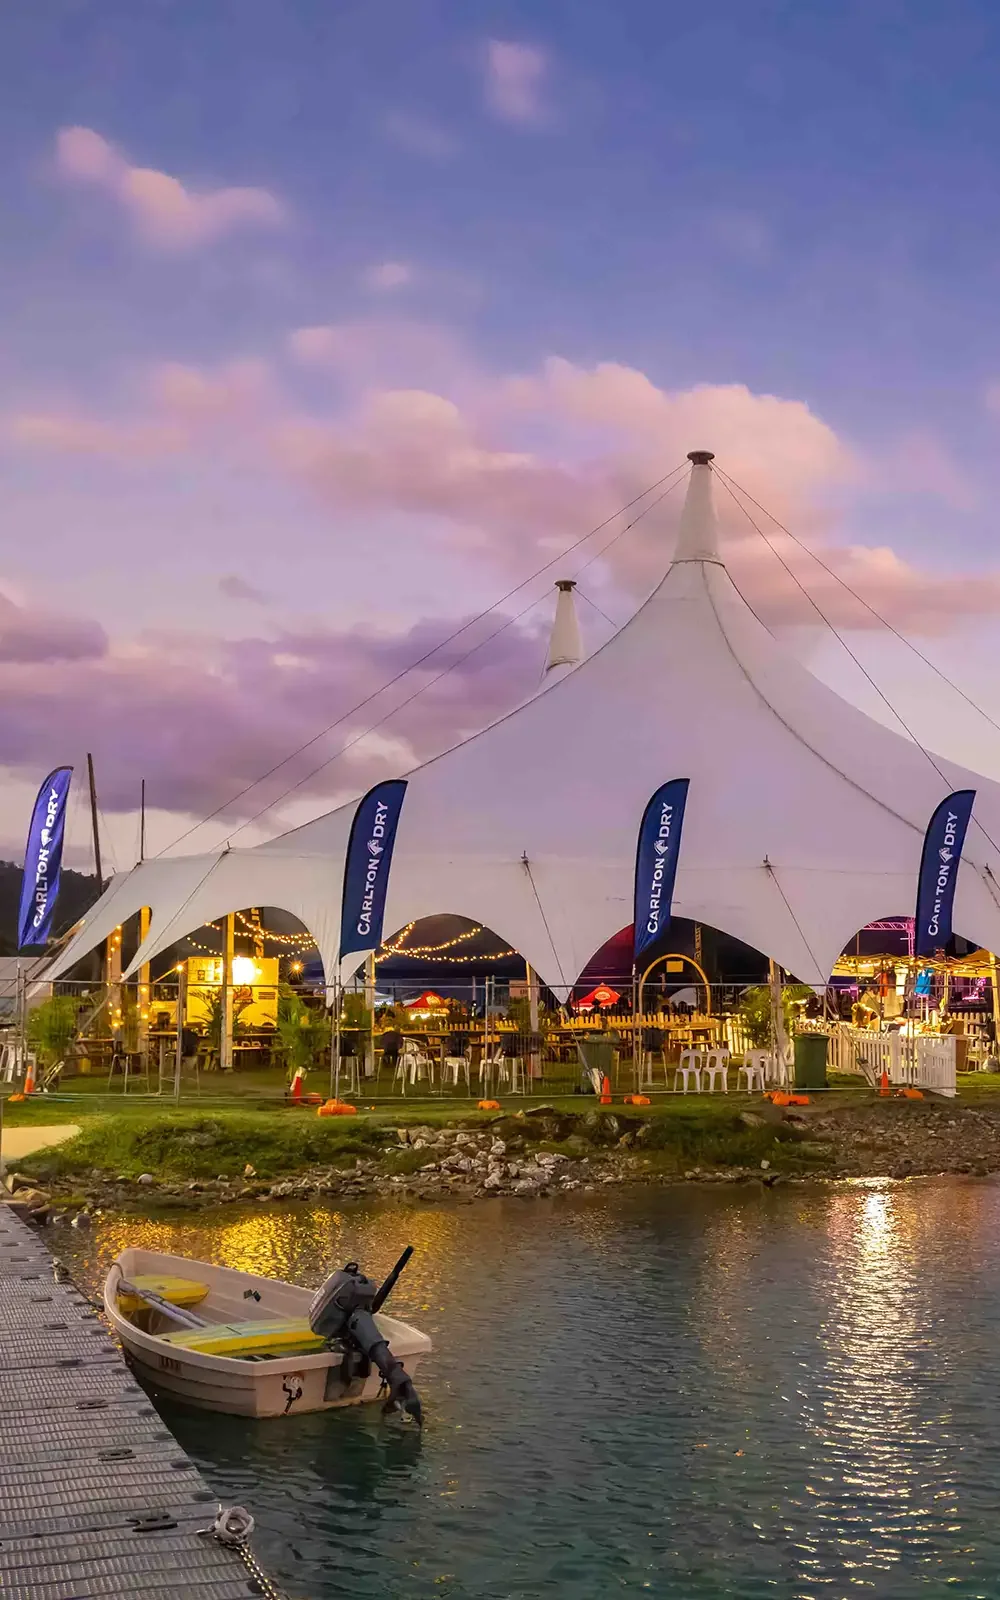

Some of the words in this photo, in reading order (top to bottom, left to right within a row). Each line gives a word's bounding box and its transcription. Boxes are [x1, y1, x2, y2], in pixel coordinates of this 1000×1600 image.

[33, 848, 50, 928] CARLTON
[46, 788, 58, 828] DRY
[357, 859, 379, 935] CARLTON
[373, 801, 388, 837] DRY
[647, 858, 665, 934] CARLTON
[659, 802, 673, 837] DRY
[944, 811, 958, 846] DRY
